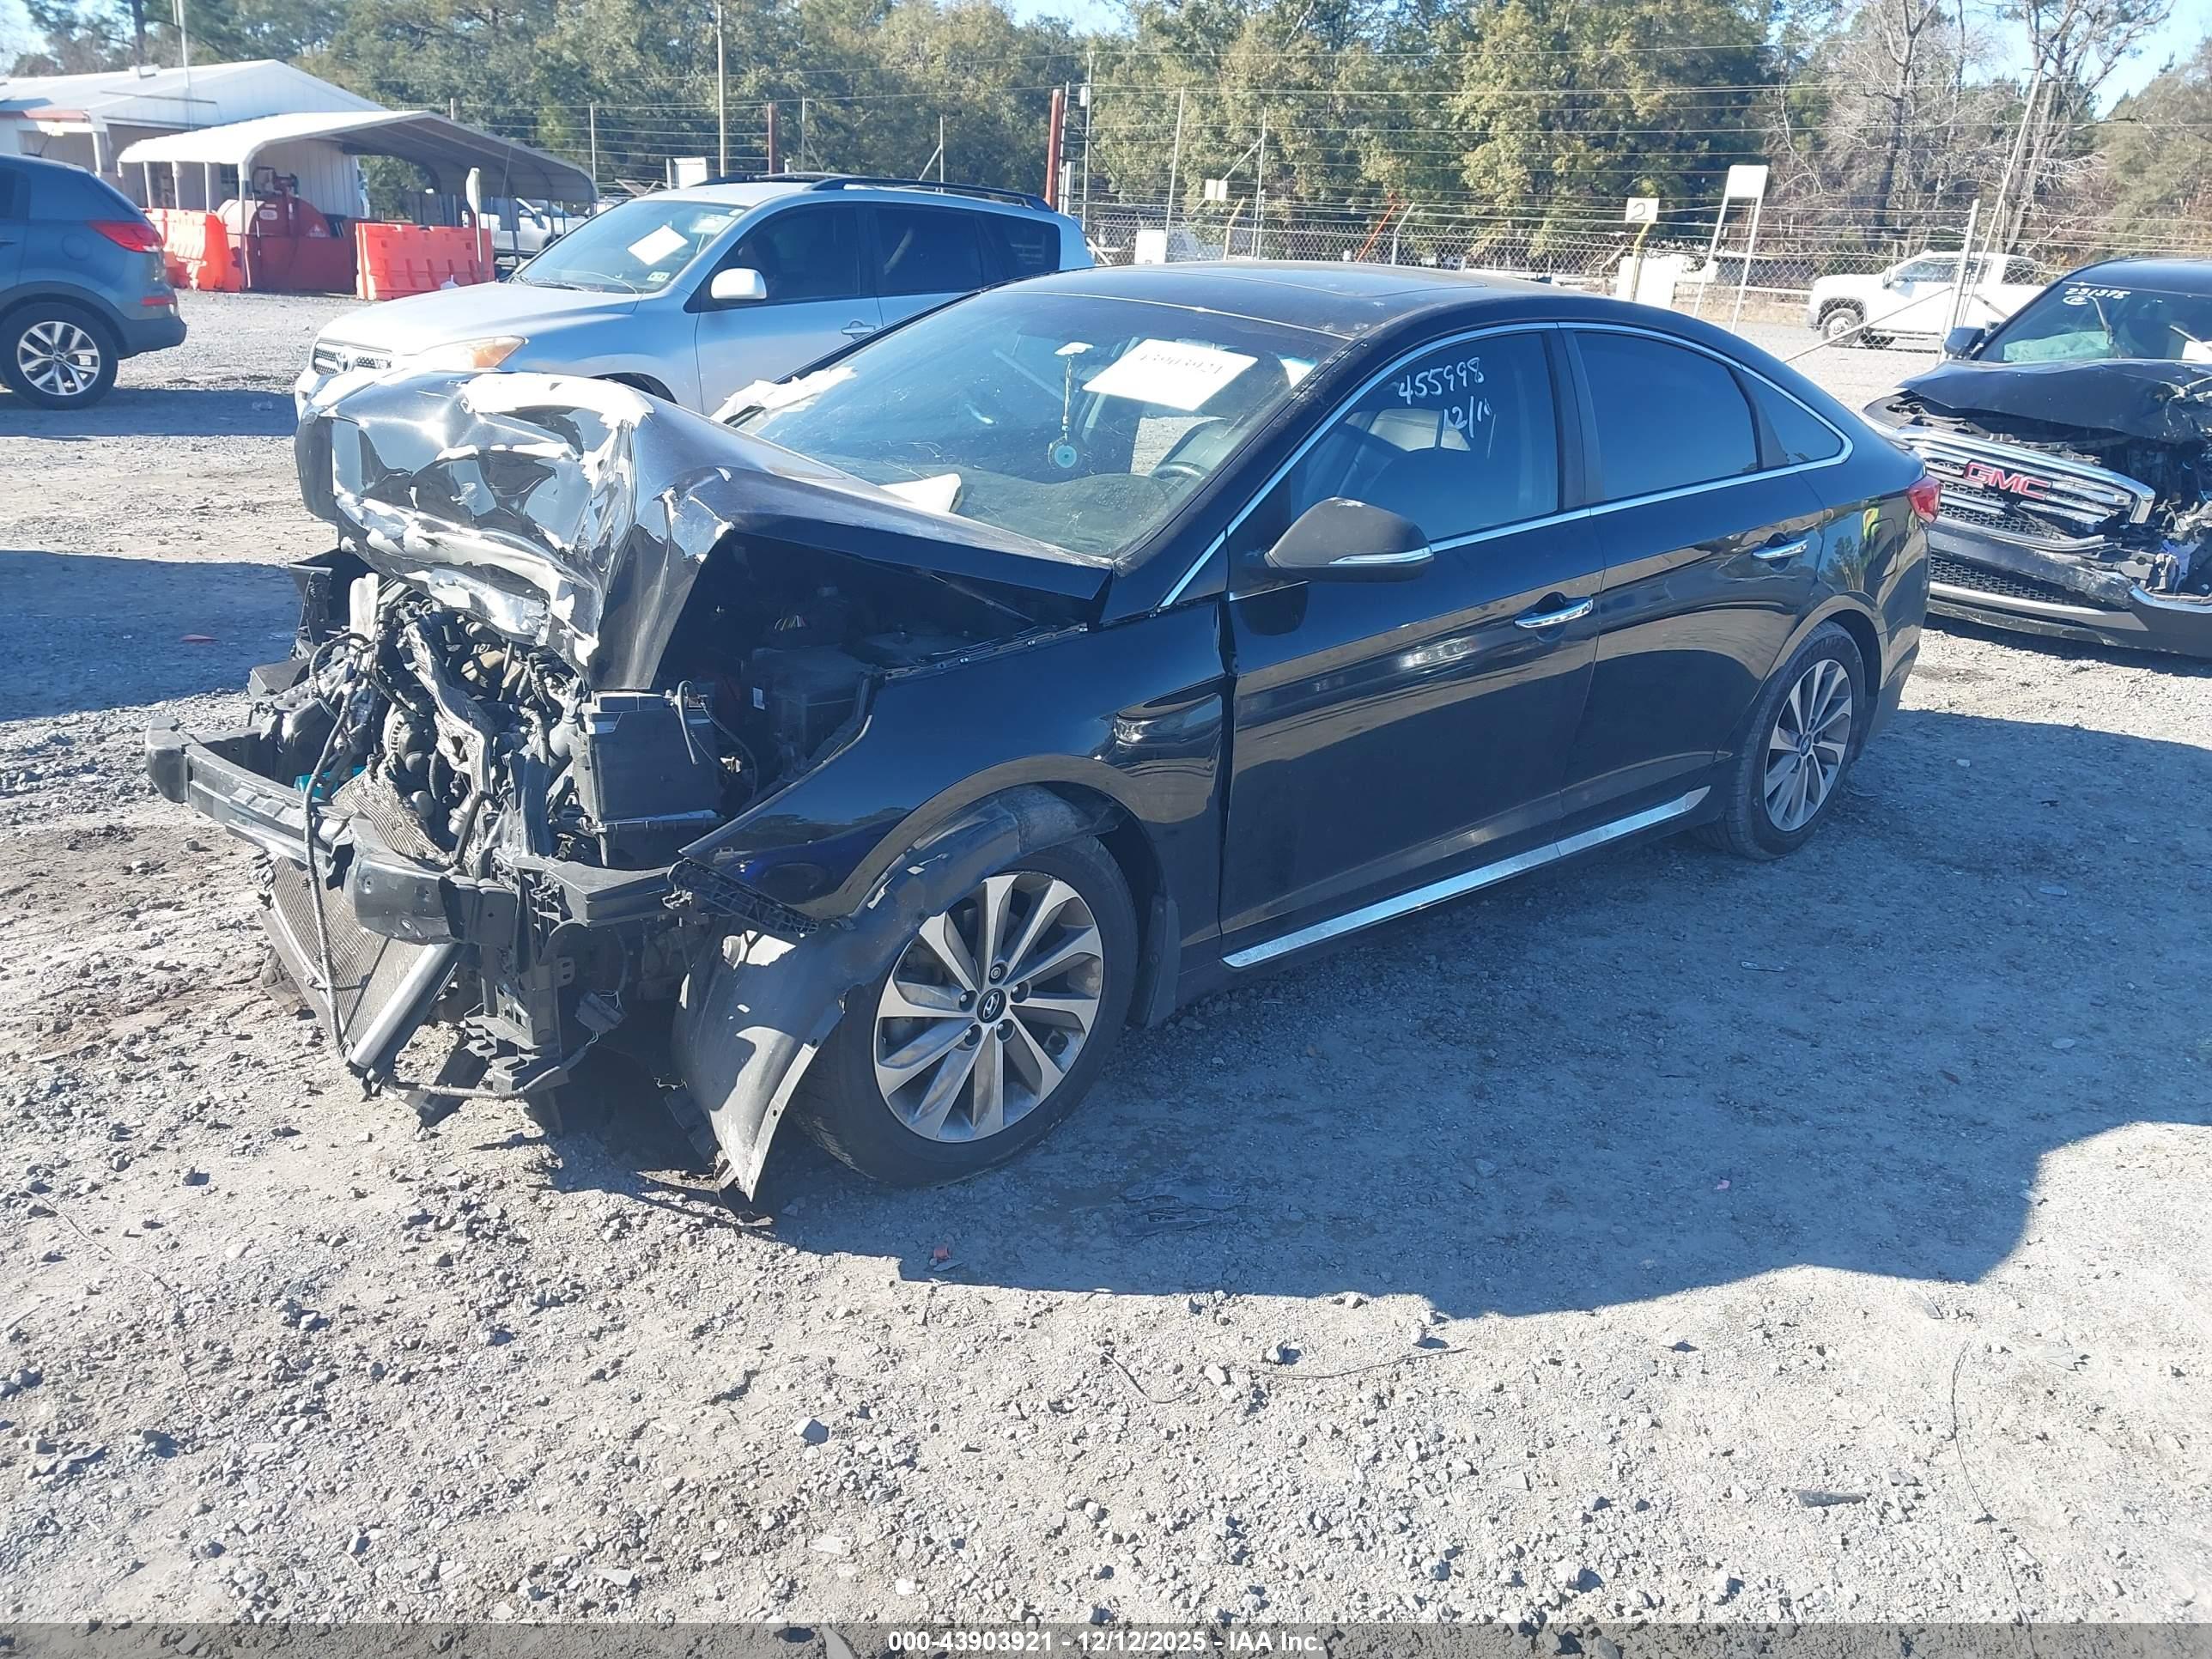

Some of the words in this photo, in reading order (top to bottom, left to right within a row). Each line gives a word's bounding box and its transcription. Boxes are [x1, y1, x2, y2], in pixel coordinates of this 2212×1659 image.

[1630, 202, 1650, 222] 2
[1398, 357, 1485, 406] 455998
[1963, 461, 2052, 501] GMC
